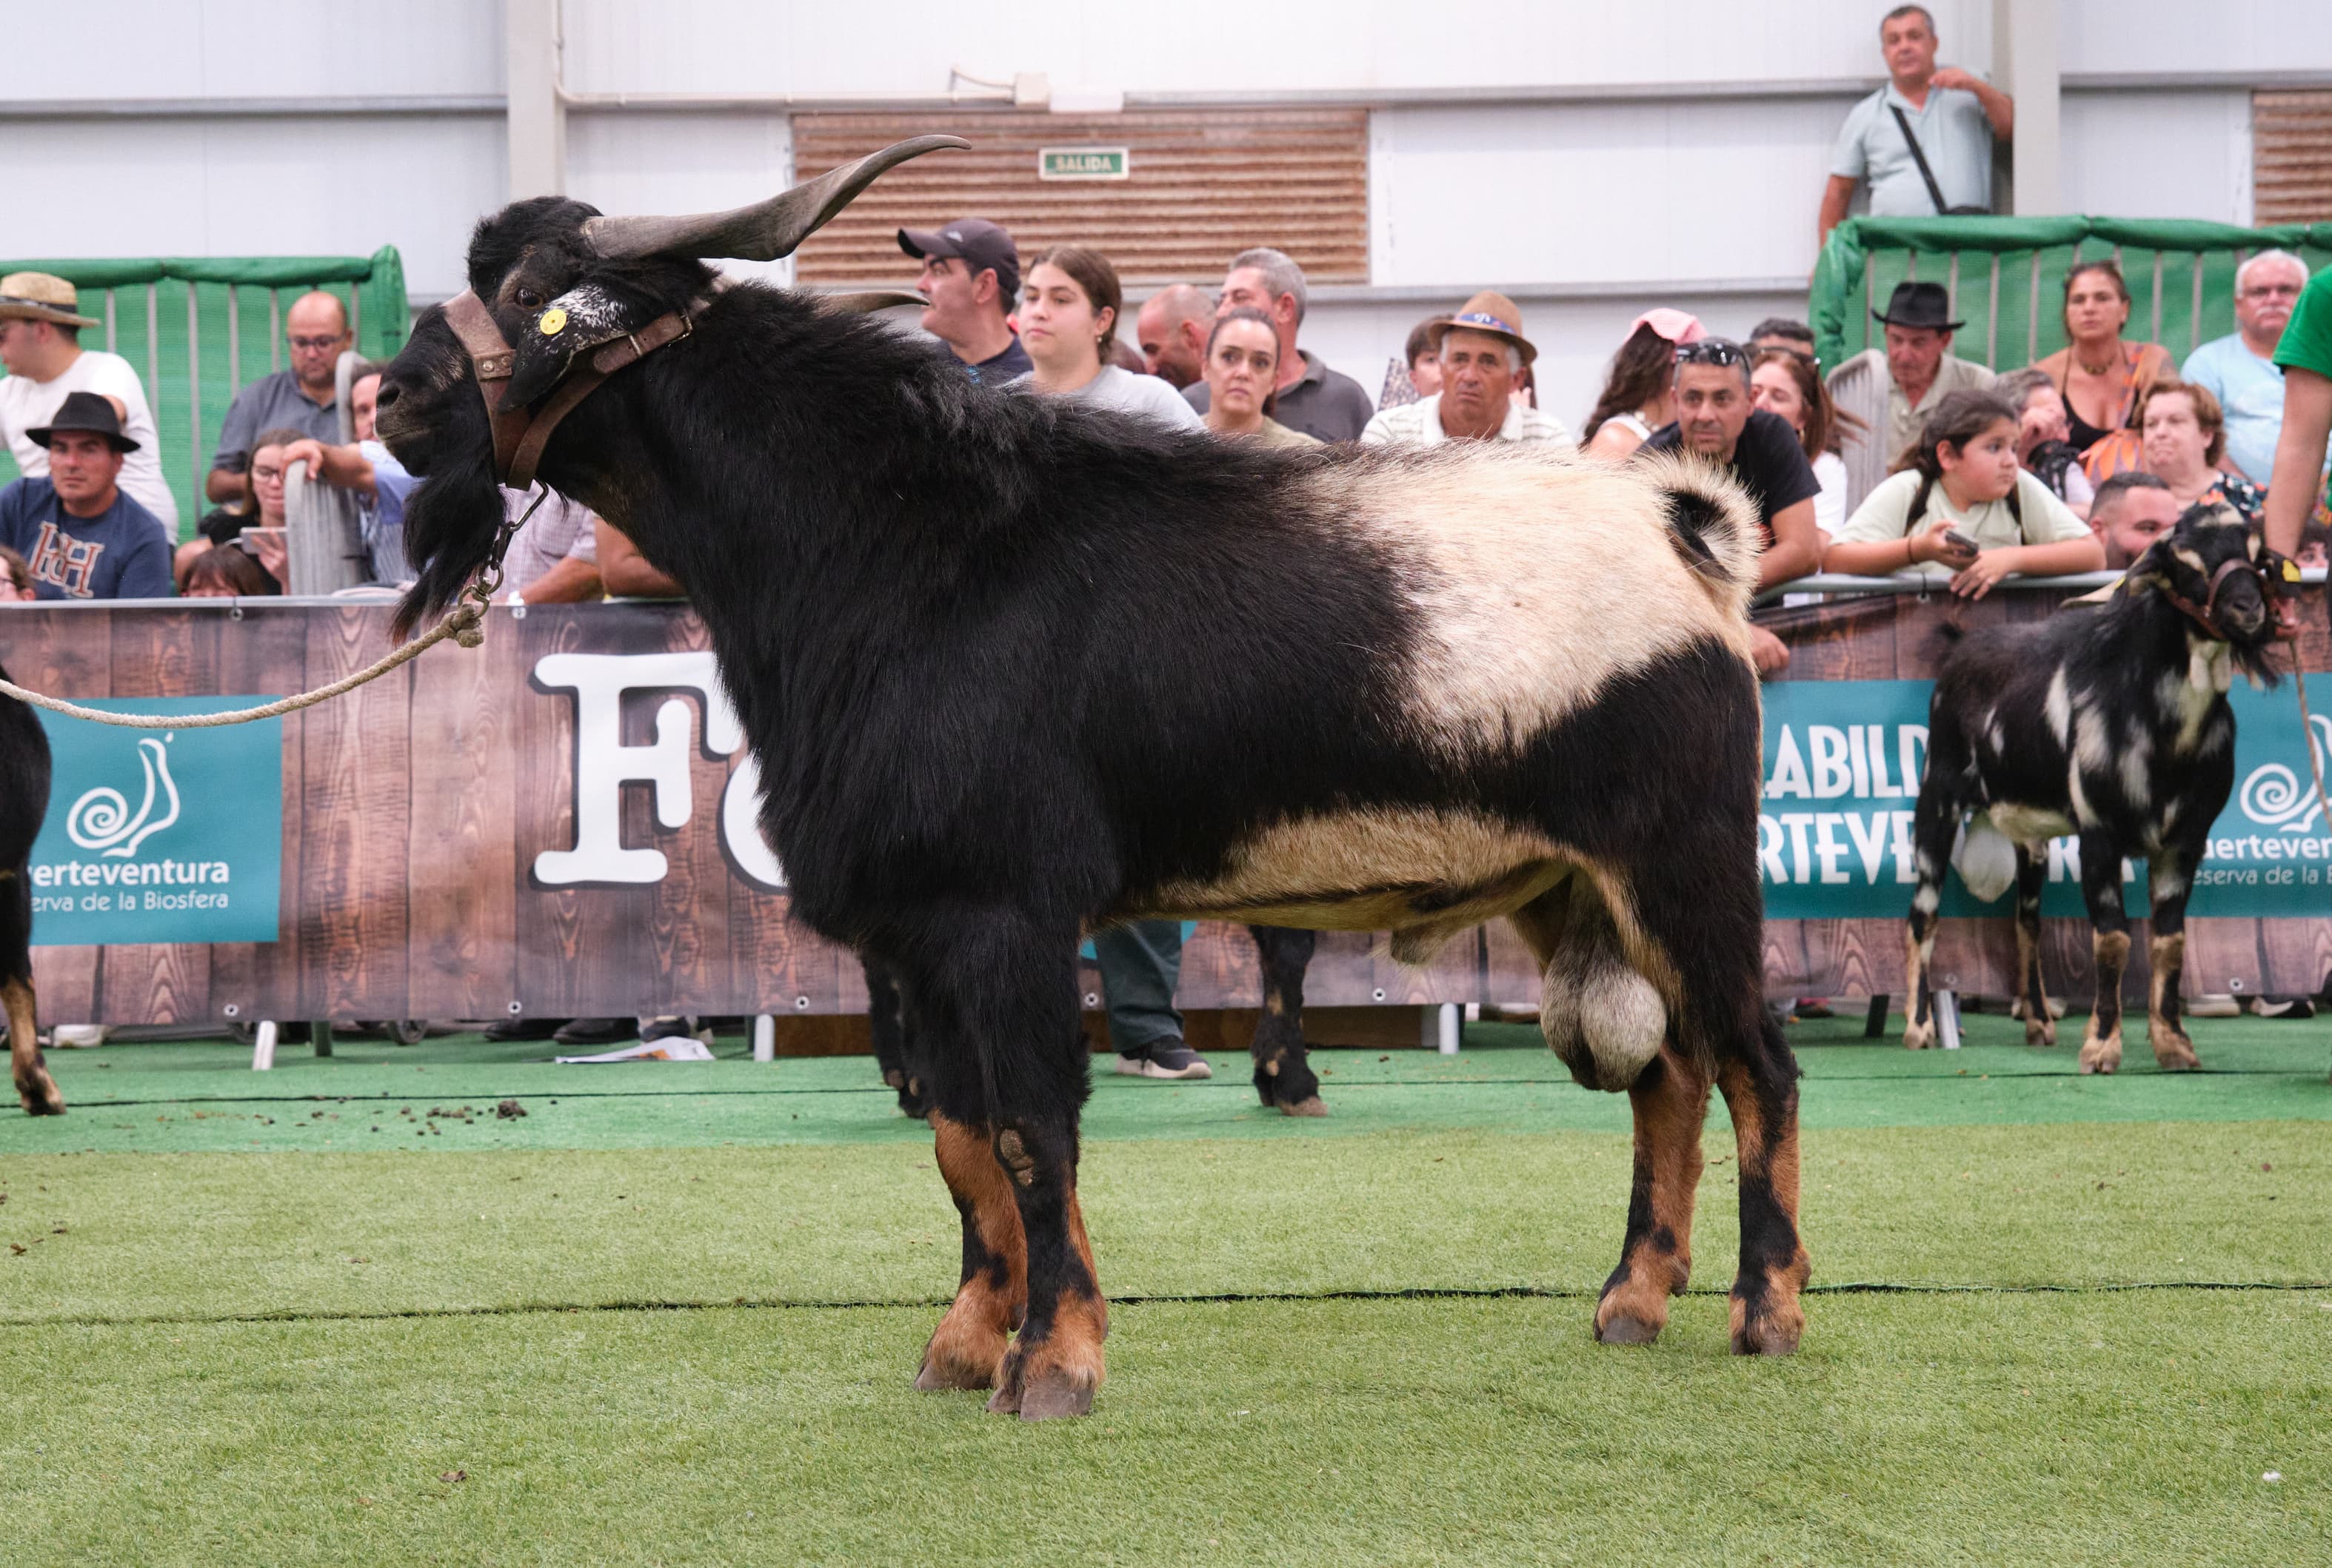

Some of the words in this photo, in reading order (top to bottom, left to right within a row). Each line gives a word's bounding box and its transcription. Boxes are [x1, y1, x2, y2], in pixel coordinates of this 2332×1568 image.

[1055, 155, 1112, 172] SALIDA
[1760, 723, 1930, 799] ABILD
[30, 859, 230, 887] erteventura
[2265, 865, 2294, 885] de
[2302, 864, 2319, 885] la
[81, 892, 111, 912] de
[118, 891, 136, 911] la
[144, 888, 229, 910] Biosfera
